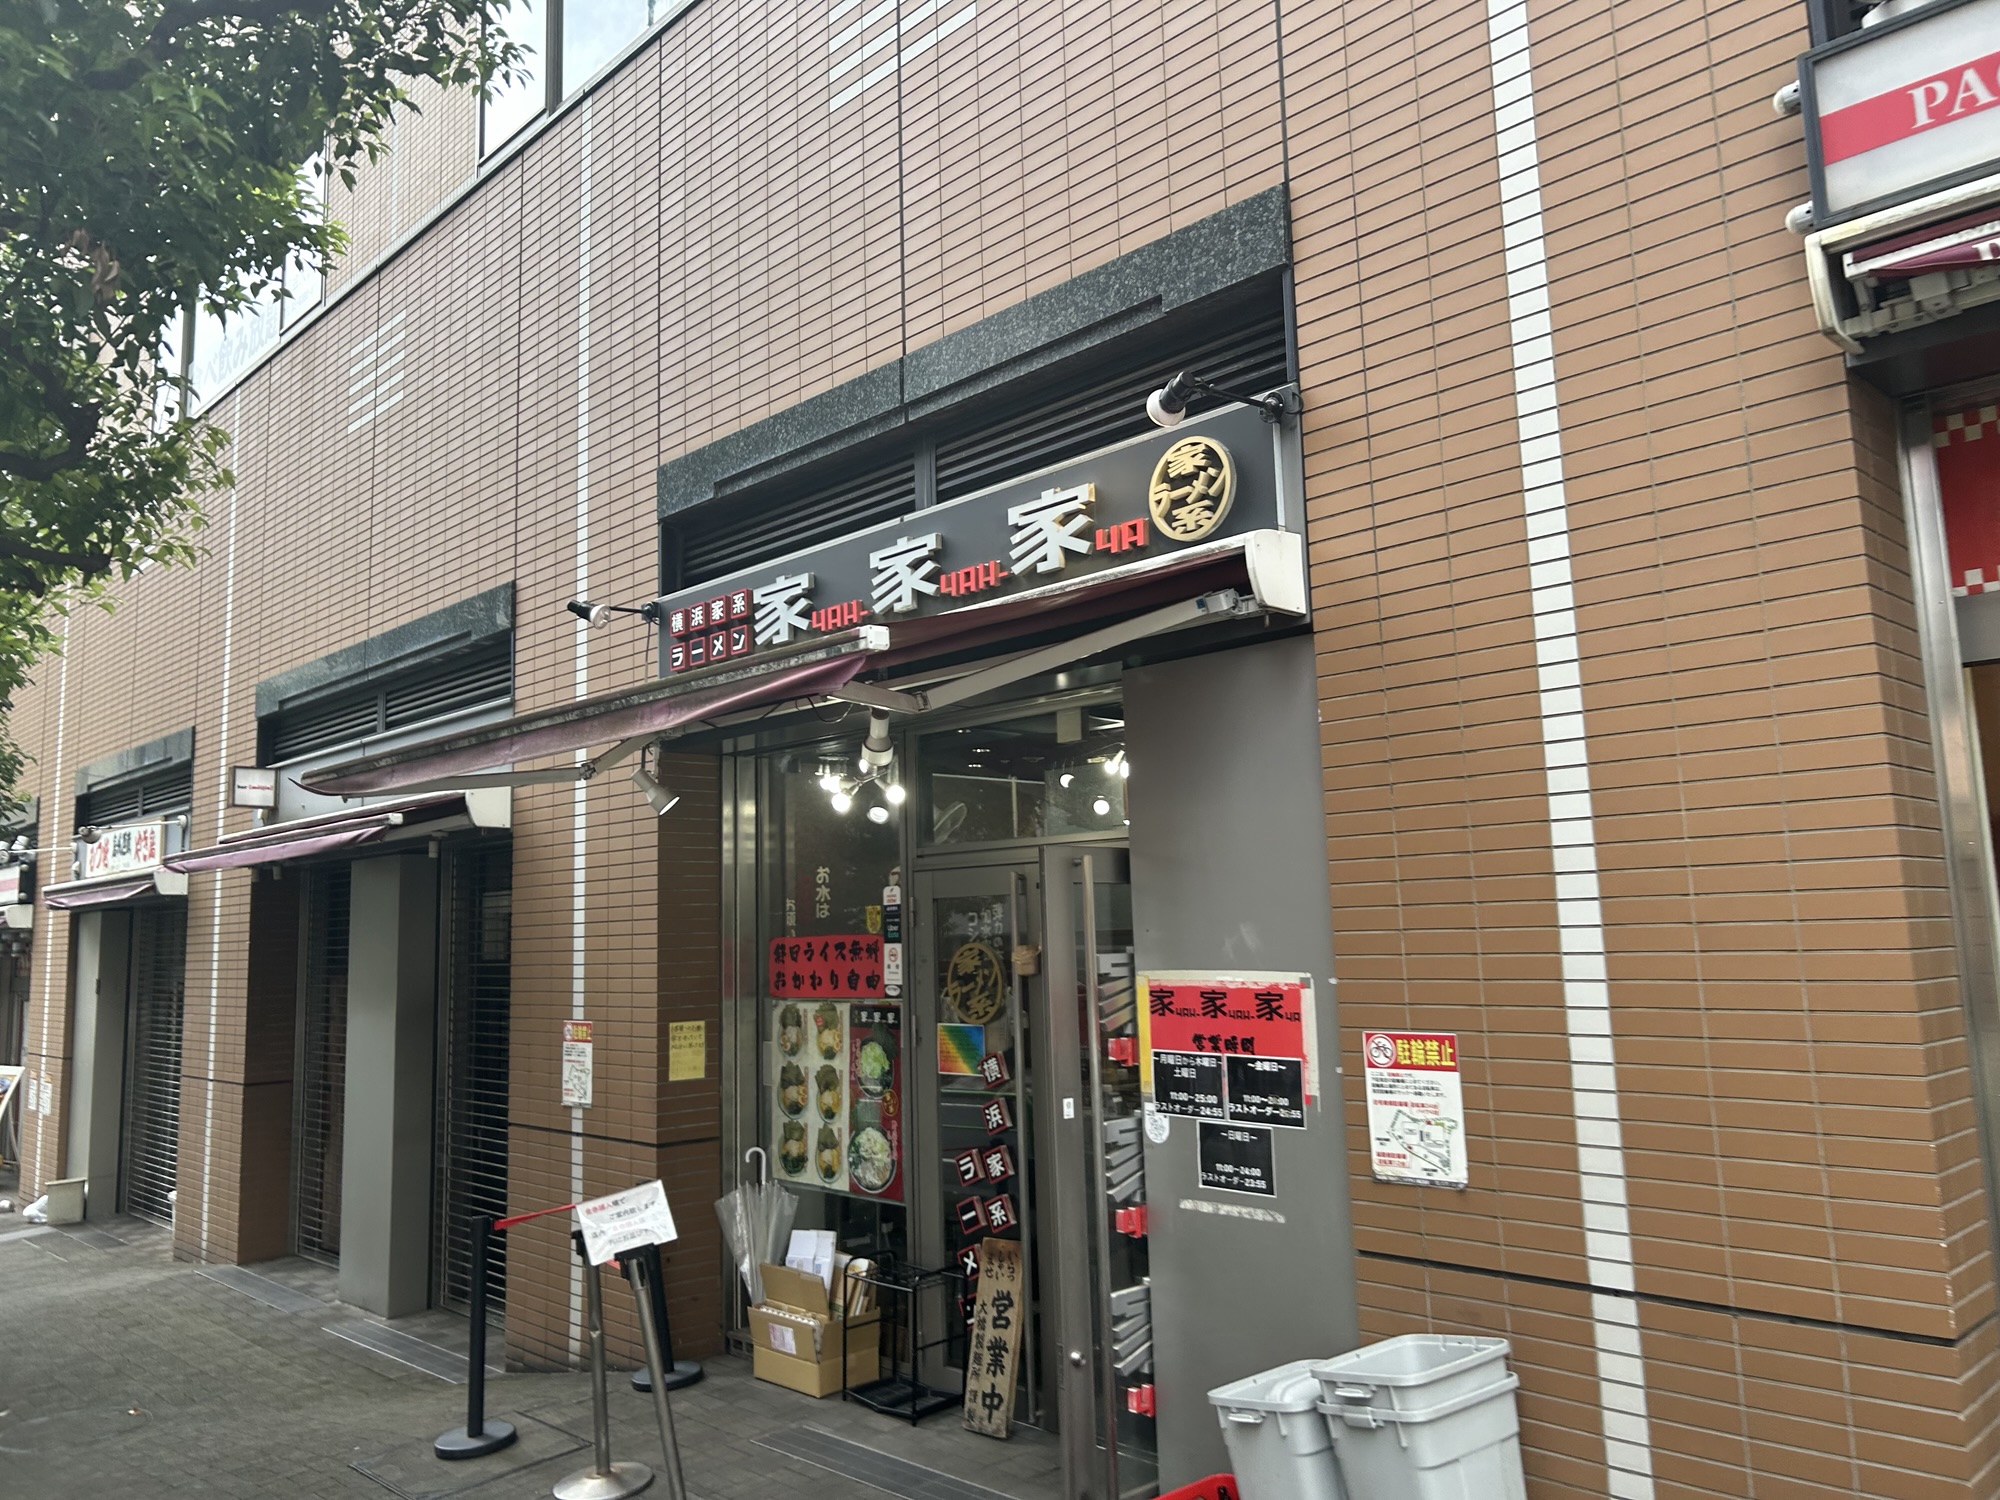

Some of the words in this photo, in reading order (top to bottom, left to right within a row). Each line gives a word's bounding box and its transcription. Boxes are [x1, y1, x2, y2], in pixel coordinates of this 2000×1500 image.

[1907, 66, 2000, 129] PA
[1166, 443, 1212, 479] 家
[1152, 466, 1228, 517] ラーメン
[752, 572, 815, 646] 家
[869, 532, 945, 616] 家
[1007, 481, 1097, 576] 家
[671, 592, 746, 633] 横浜家系
[671, 632, 746, 666] ラーメン
[815, 866, 831, 919] お水は
[774, 968, 881, 991] おかわり自由
[955, 946, 981, 976] 家
[1149, 988, 1175, 1016] 家
[1200, 989, 1227, 1018] 家
[1254, 991, 1284, 1021] 家
[1395, 1038, 1456, 1067] 駐輪禁止
[1173, 1067, 1197, 1079] 土曜日
[982, 1057, 1008, 1227] 横浜家系
[981, 1288, 1015, 1424] 営業中
